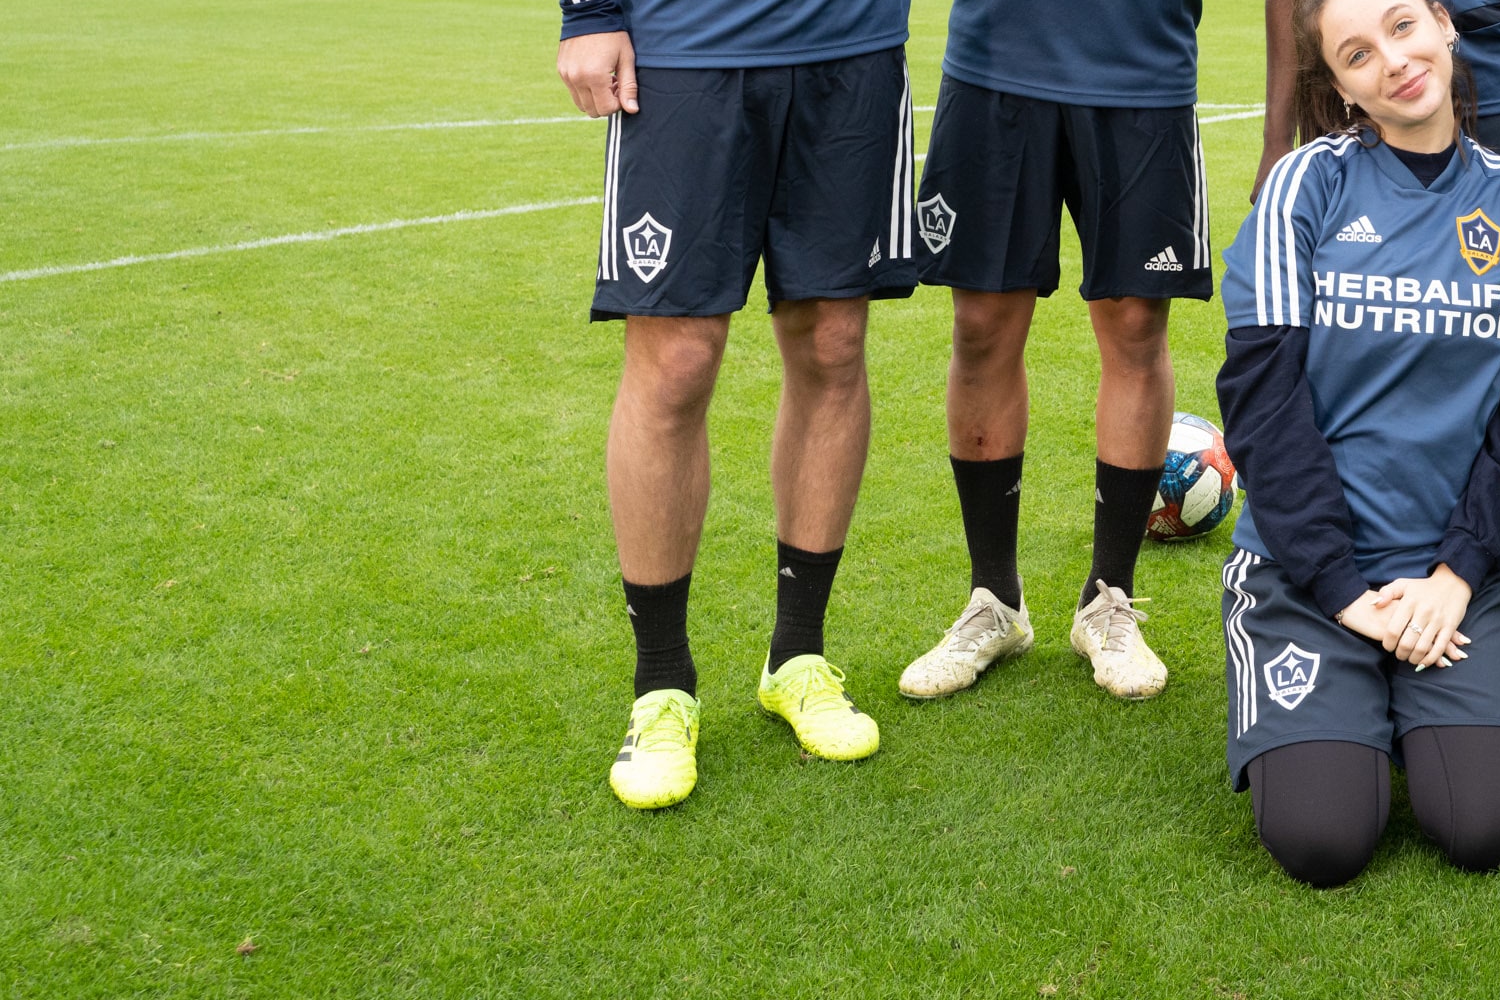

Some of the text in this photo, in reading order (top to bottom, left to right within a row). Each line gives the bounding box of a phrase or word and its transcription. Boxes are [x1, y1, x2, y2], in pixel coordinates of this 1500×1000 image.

[926, 212, 947, 234] LA
[635, 238, 661, 257] LA
[1336, 231, 1383, 244] adidas
[1468, 230, 1493, 252] LA
[1143, 260, 1183, 273] adidas
[1277, 665, 1308, 687] LA
